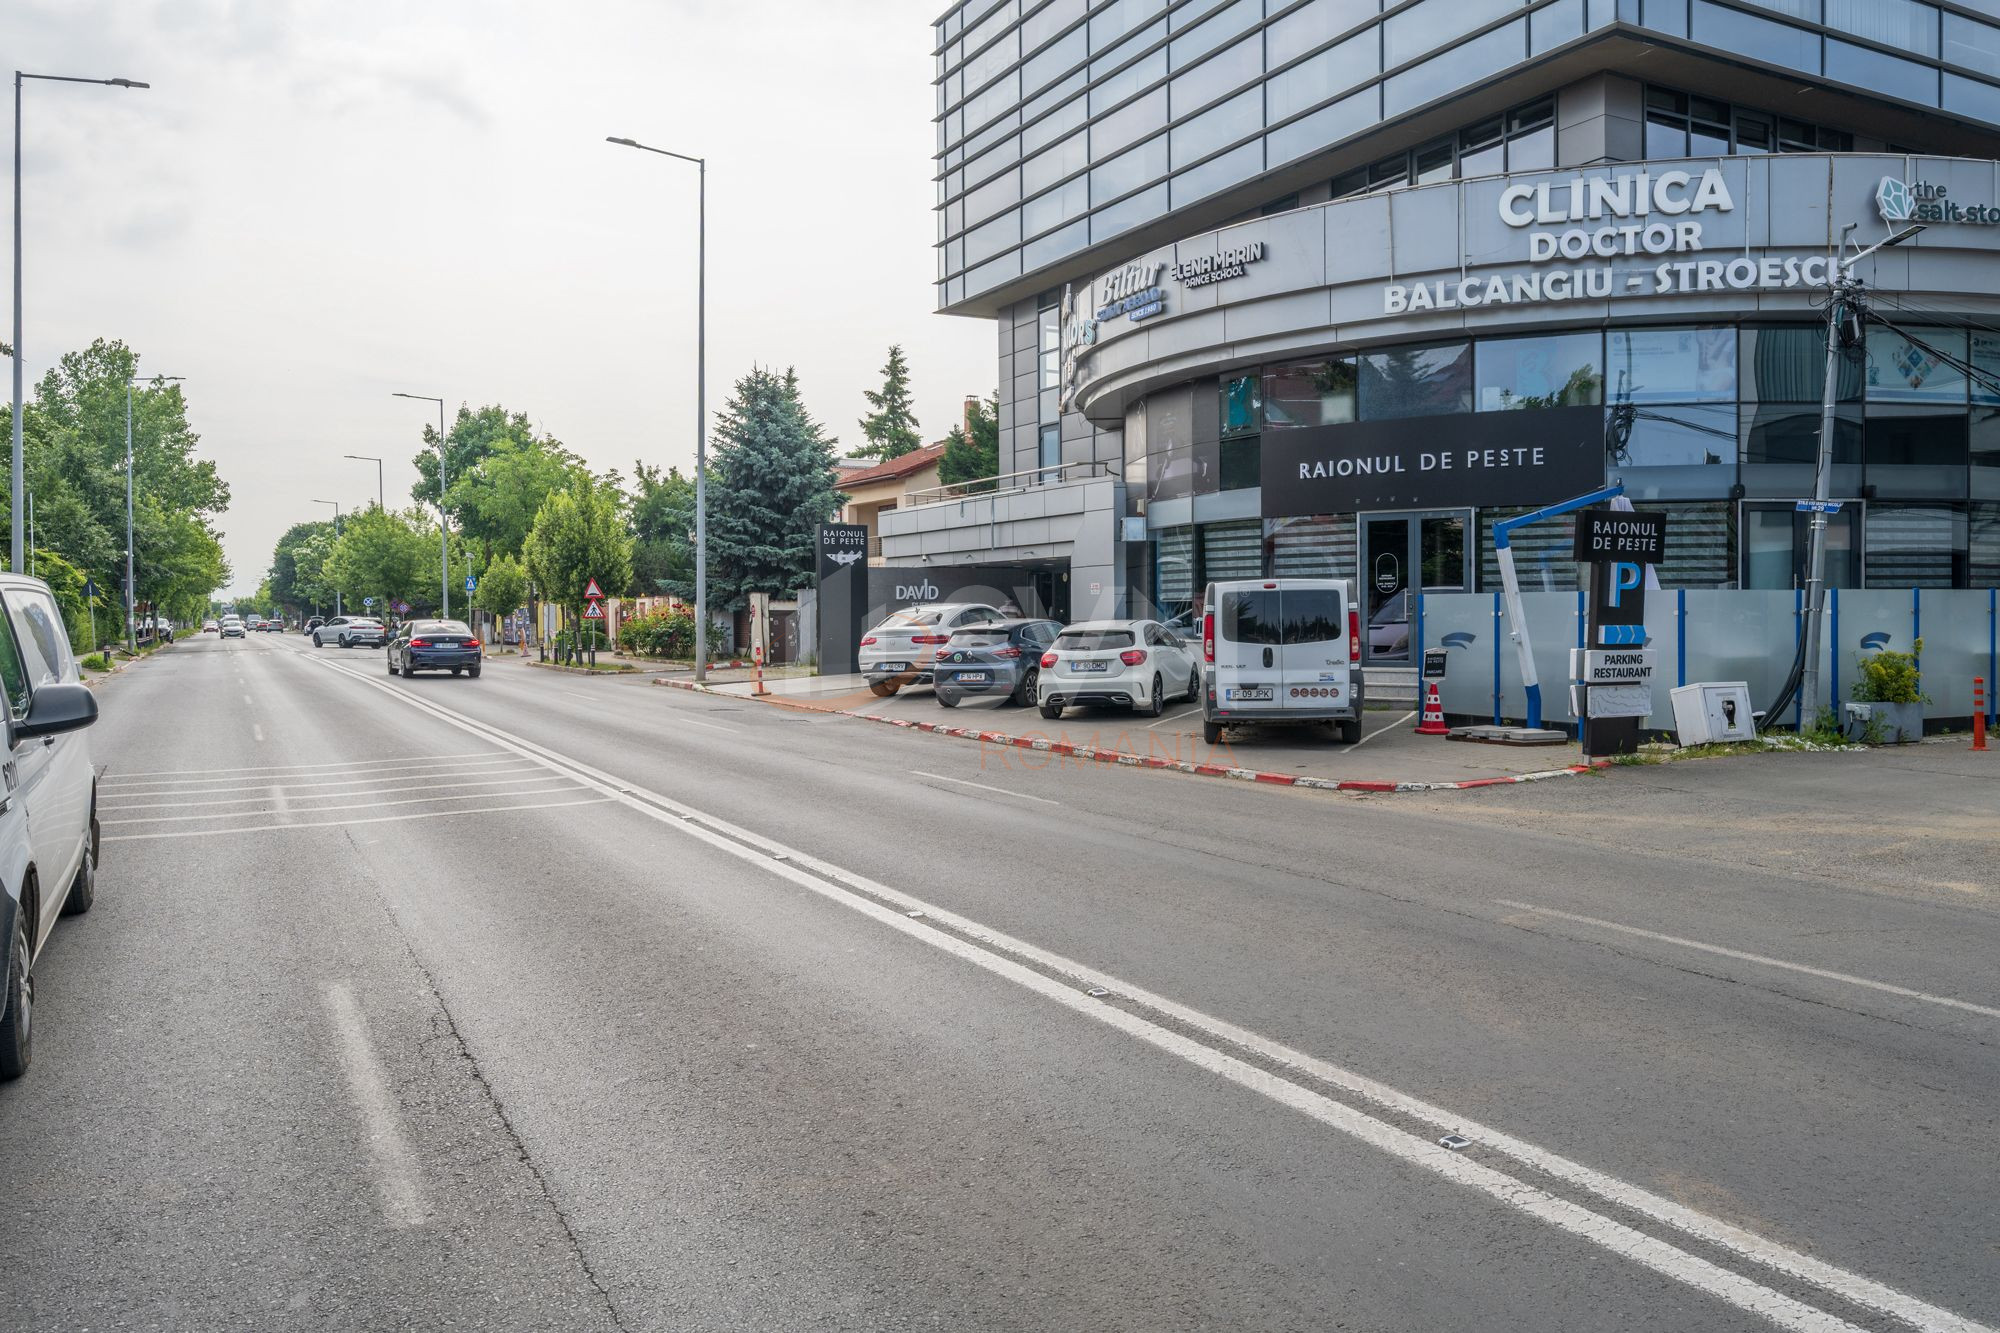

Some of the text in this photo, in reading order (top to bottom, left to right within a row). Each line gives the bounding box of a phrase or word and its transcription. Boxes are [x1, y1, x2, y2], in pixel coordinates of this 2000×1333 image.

[1498, 168, 1735, 227] CLINICA
[1915, 180, 1947, 198] the
[1918, 200, 1960, 221] salt
[1529, 220, 1703, 263] DOCTOR
[1169, 241, 1264, 281] ELENA MARIN
[1100, 262, 1161, 306] Biltur
[1184, 265, 1244, 288] DANCE SCHOOL
[1384, 266, 1612, 315] BALCANGIU
[1299, 455, 1406, 480] RAIONUL
[1420, 452, 1453, 471] DE
[823, 529, 865, 538] RAIONUL
[1593, 520, 1658, 536] RAIONUL
[823, 537, 836, 545] DE
[1592, 537, 1612, 550] DE
[895, 578, 940, 600] DAVID
[1609, 562, 1642, 608] P
[1604, 654, 1643, 665] PARKING
[1594, 667, 1653, 679] RESTAURANT
[1232, 690, 1270, 698] IF 09 JPK
